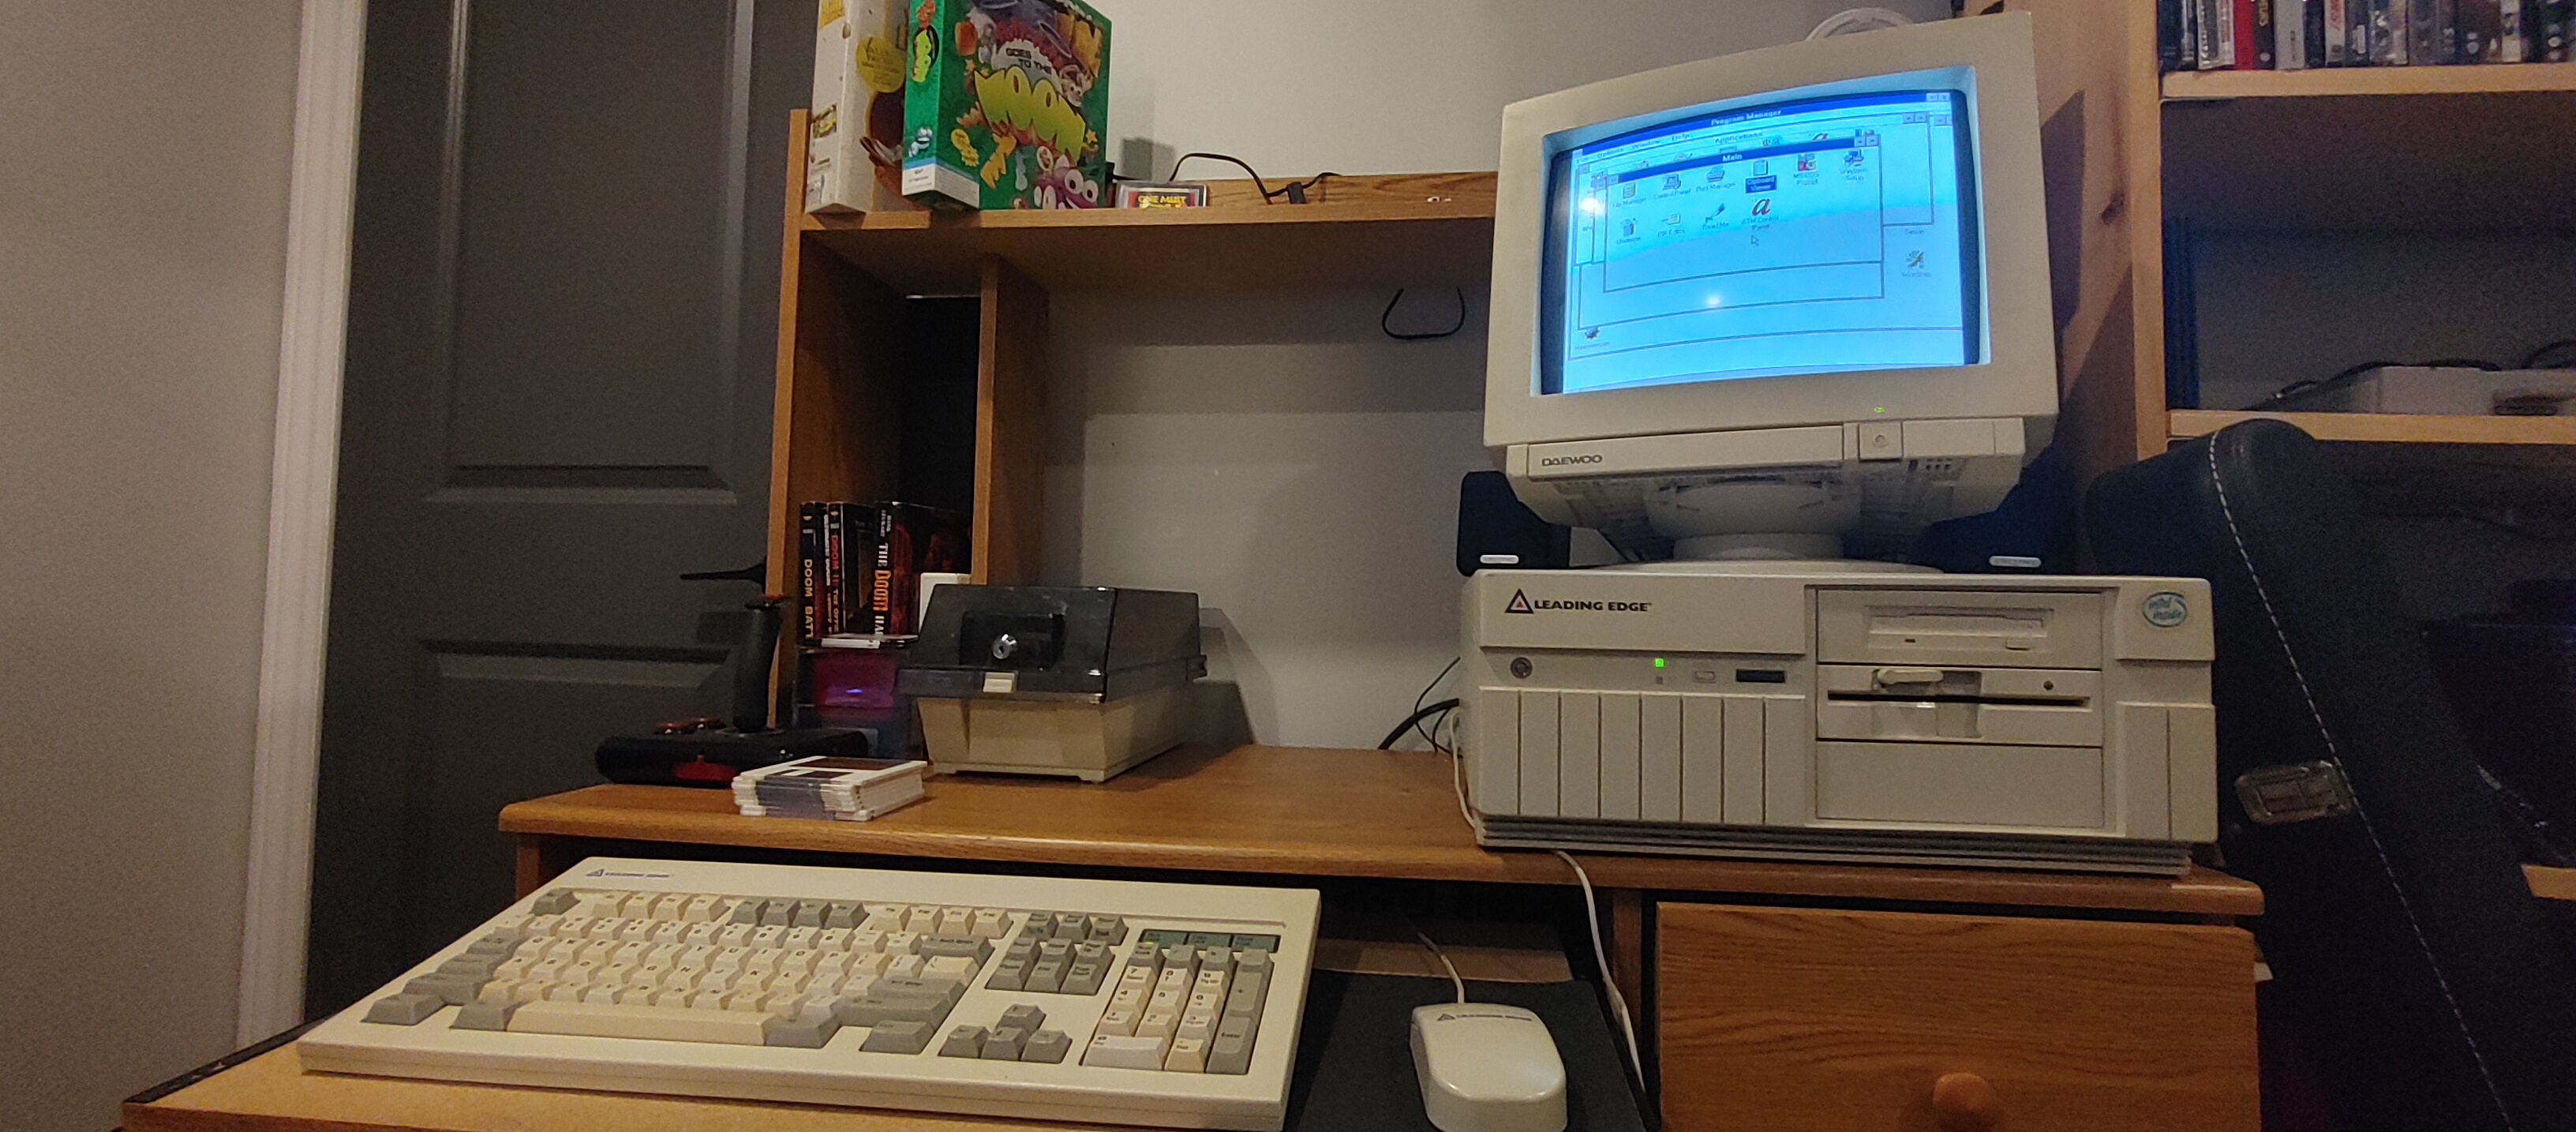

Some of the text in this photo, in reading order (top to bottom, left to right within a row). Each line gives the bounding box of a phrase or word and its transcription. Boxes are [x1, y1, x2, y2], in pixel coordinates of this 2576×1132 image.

[1005, 47, 1032, 60] GOES
[1018, 58, 1052, 75] TO THE
[1746, 109, 1782, 121] Manager
[1714, 131, 1764, 144] Applications
[1722, 152, 1743, 163] Main
[1541, 454, 1603, 467] DAEWOO
[830, 534, 840, 569] DOOM
[877, 542, 889, 568] THE
[804, 559, 813, 597] DOOM
[873, 569, 892, 611] DOOM
[1534, 600, 1649, 612] LEADING EDGE
